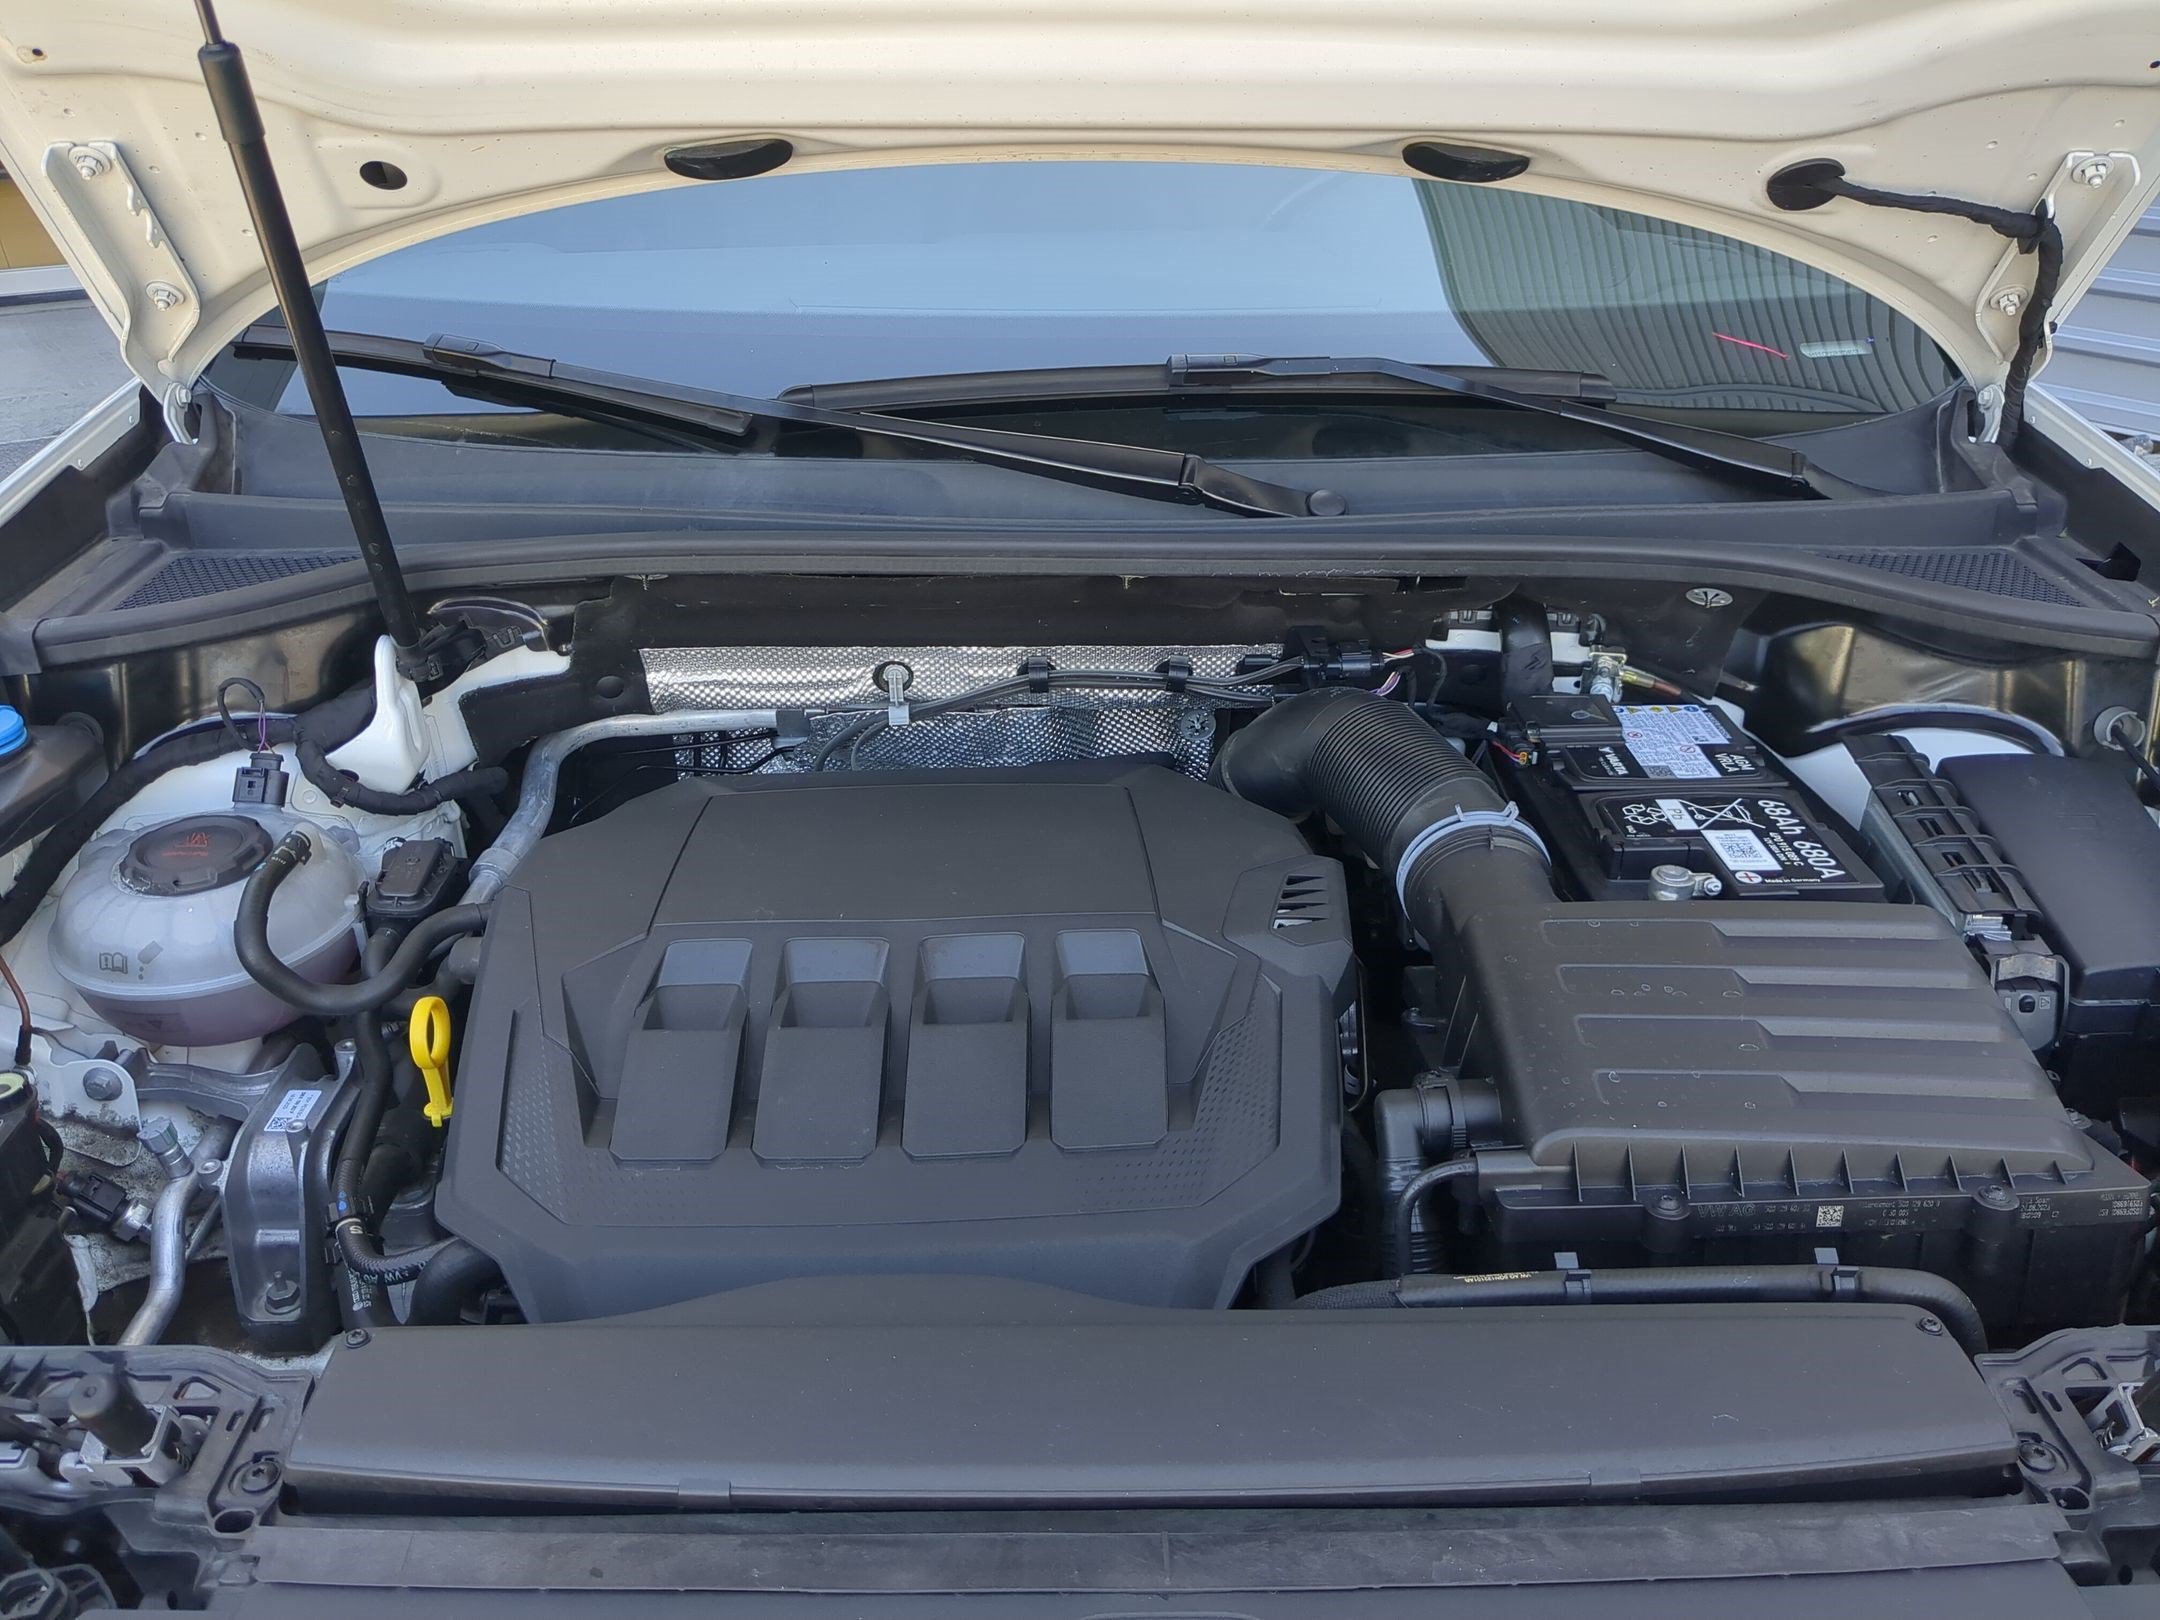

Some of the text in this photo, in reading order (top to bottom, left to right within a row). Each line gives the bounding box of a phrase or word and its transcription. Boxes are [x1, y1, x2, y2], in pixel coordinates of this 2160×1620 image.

[1605, 753, 1629, 775] VARTA
[1714, 752, 1740, 772] VRLA
[1730, 754, 1755, 770] AGM
[1667, 807, 1683, 822] Pb
[1758, 800, 1846, 879] 68Ah 680A
[1697, 1204, 1727, 1218] VW
[1729, 1203, 1756, 1217] AG
